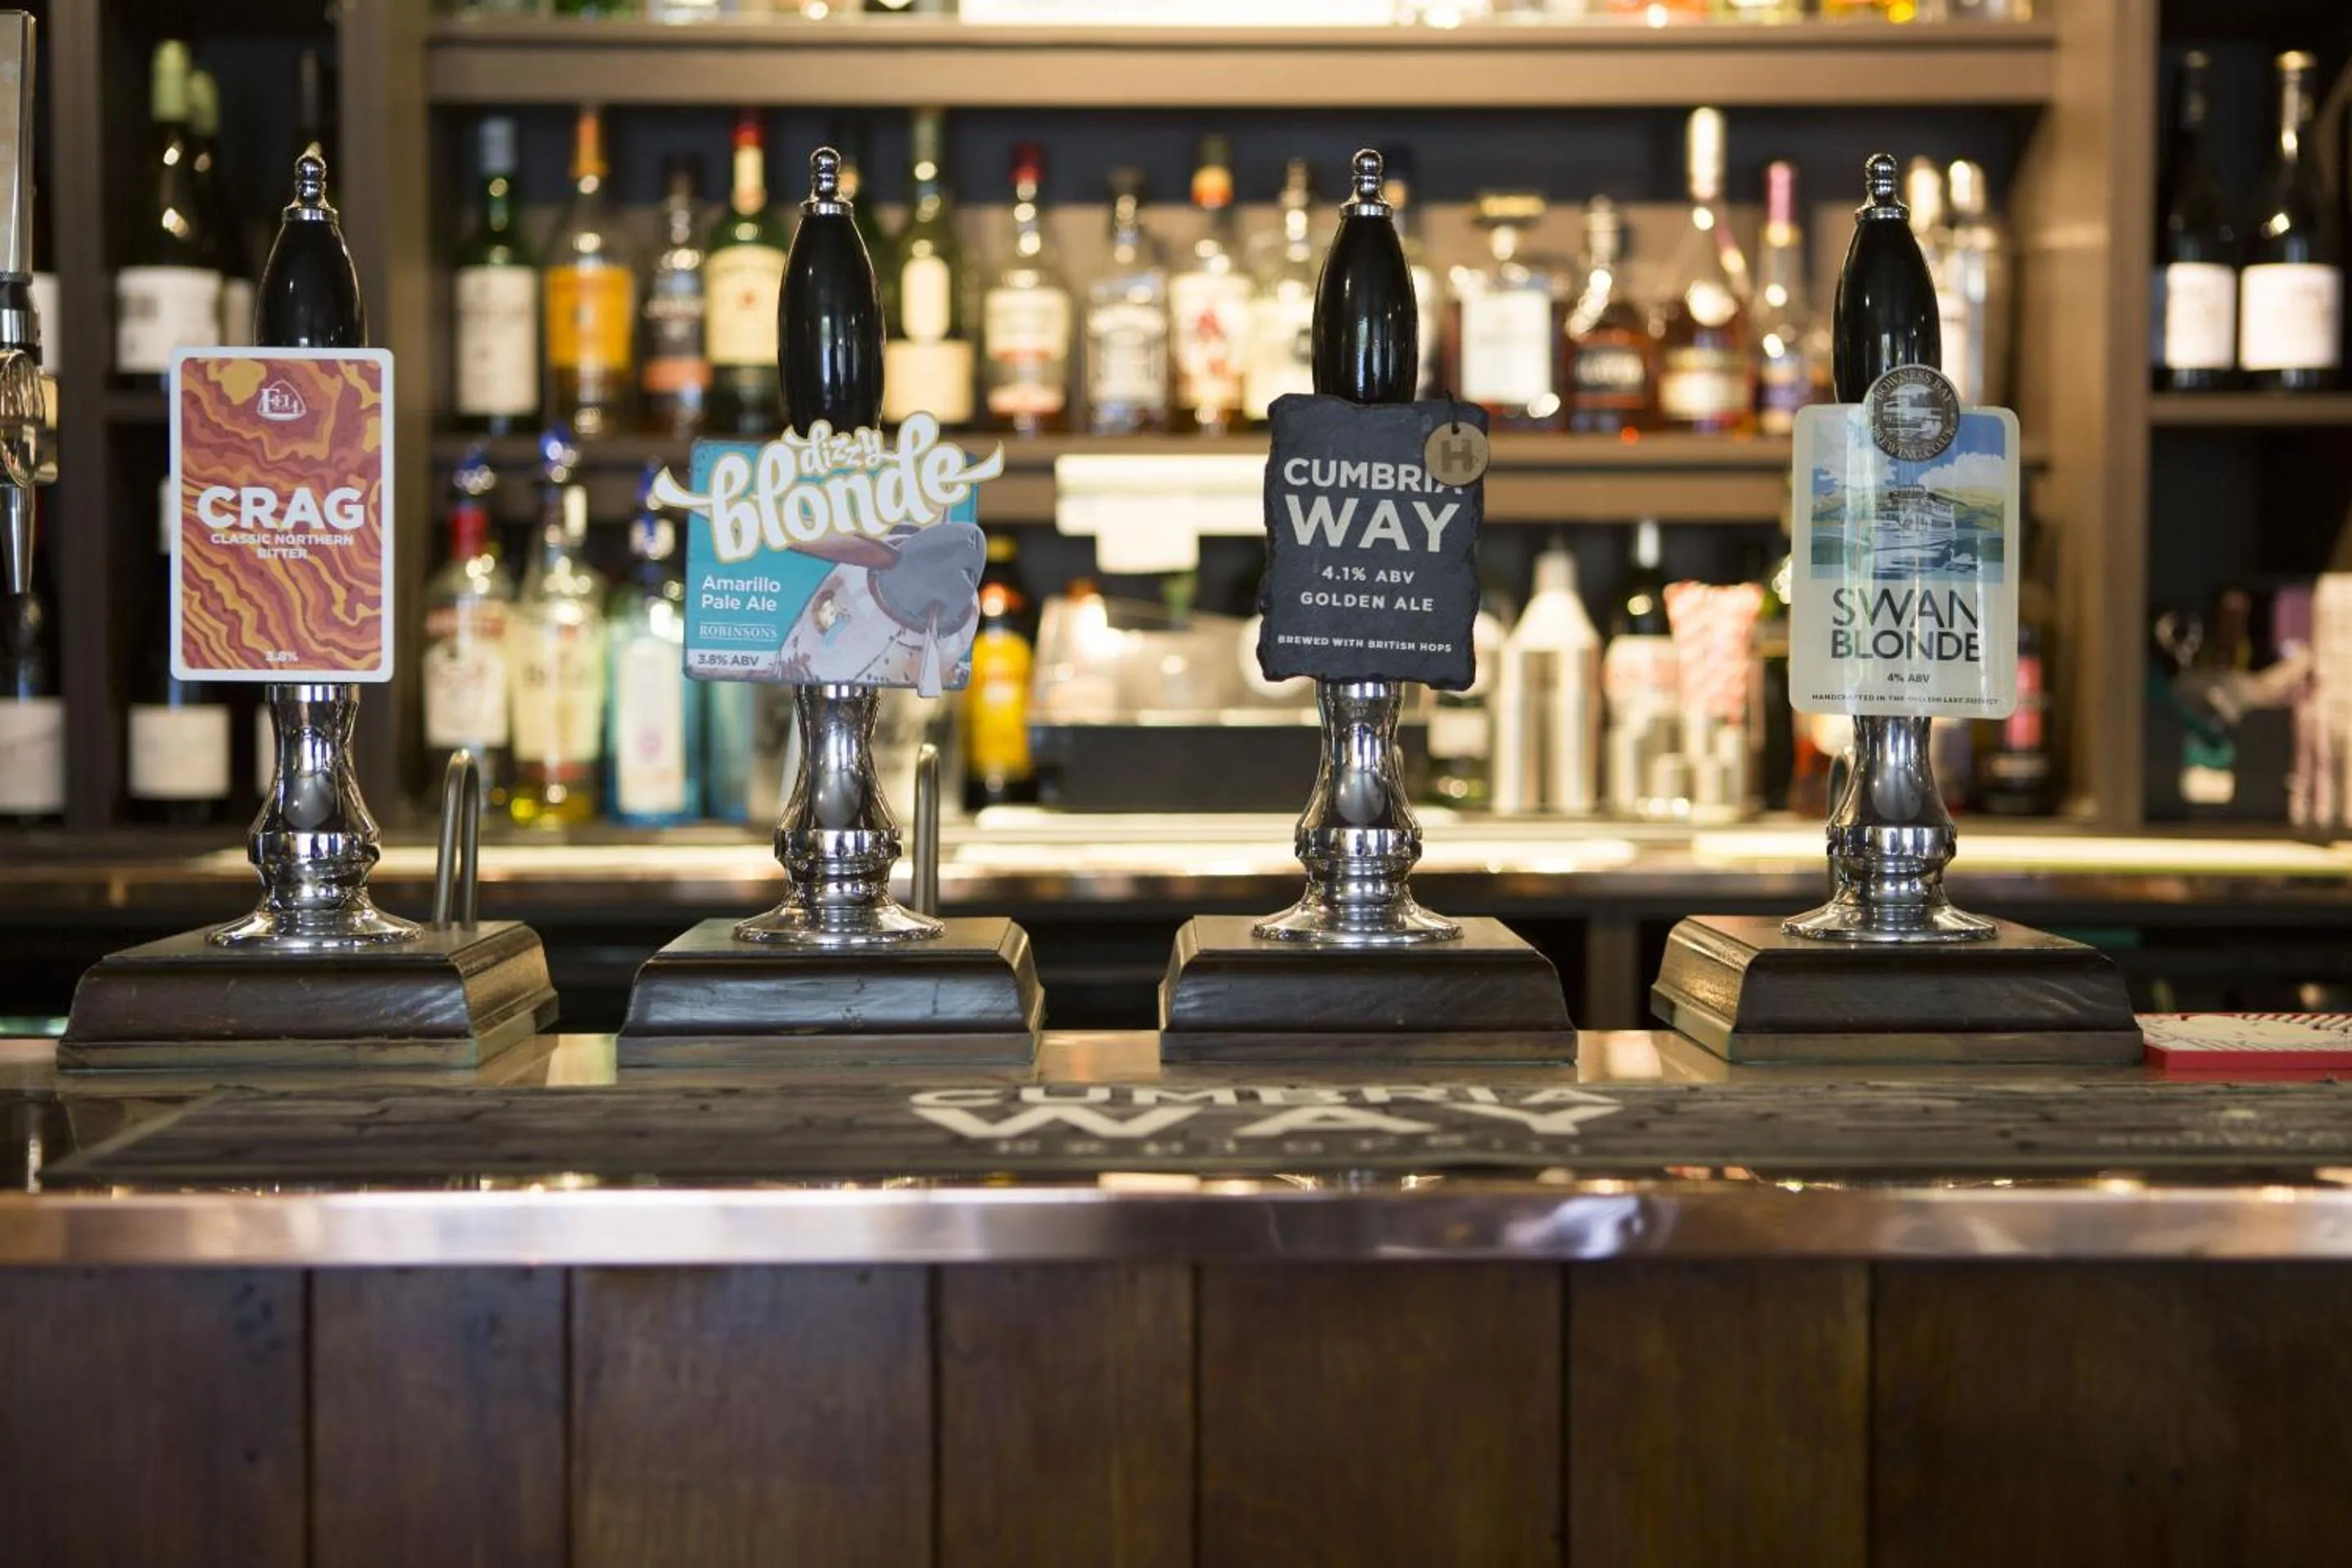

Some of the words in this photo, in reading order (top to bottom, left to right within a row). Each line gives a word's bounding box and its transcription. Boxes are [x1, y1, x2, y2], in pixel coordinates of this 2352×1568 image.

[781, 420, 898, 475] dizzy
[652, 411, 1004, 563] blonde
[197, 486, 365, 531] CRAG
[1284, 494, 1461, 553] WAY
[211, 534, 270, 544] CLASSIC
[274, 534, 353, 545] NORTHERN
[257, 548, 308, 559] BITTER
[702, 575, 781, 593] Amarillo
[1322, 566, 1367, 581] 4.1%
[1375, 570, 1415, 584] ABV
[701, 593, 740, 611] Pale
[746, 596, 777, 612] Ale
[1300, 592, 1385, 610] GOLDEN
[1394, 597, 1434, 612] ALE
[1832, 587, 1979, 629] SWAN
[699, 624, 778, 638] ROBINSONS
[1278, 634, 1329, 646] BREWED
[1332, 637, 1363, 648] WITH
[1367, 640, 1416, 651] BRITISH
[1419, 643, 1452, 653] HOPS
[1830, 629, 1981, 662] BLONDE
[730, 655, 759, 667] ABV
[1907, 673, 1930, 683] ABV
[1812, 694, 1874, 702] HANDCRTED
[909, 1085, 1623, 1108] CUMBRIA
[909, 1104, 1625, 1139] WAY
